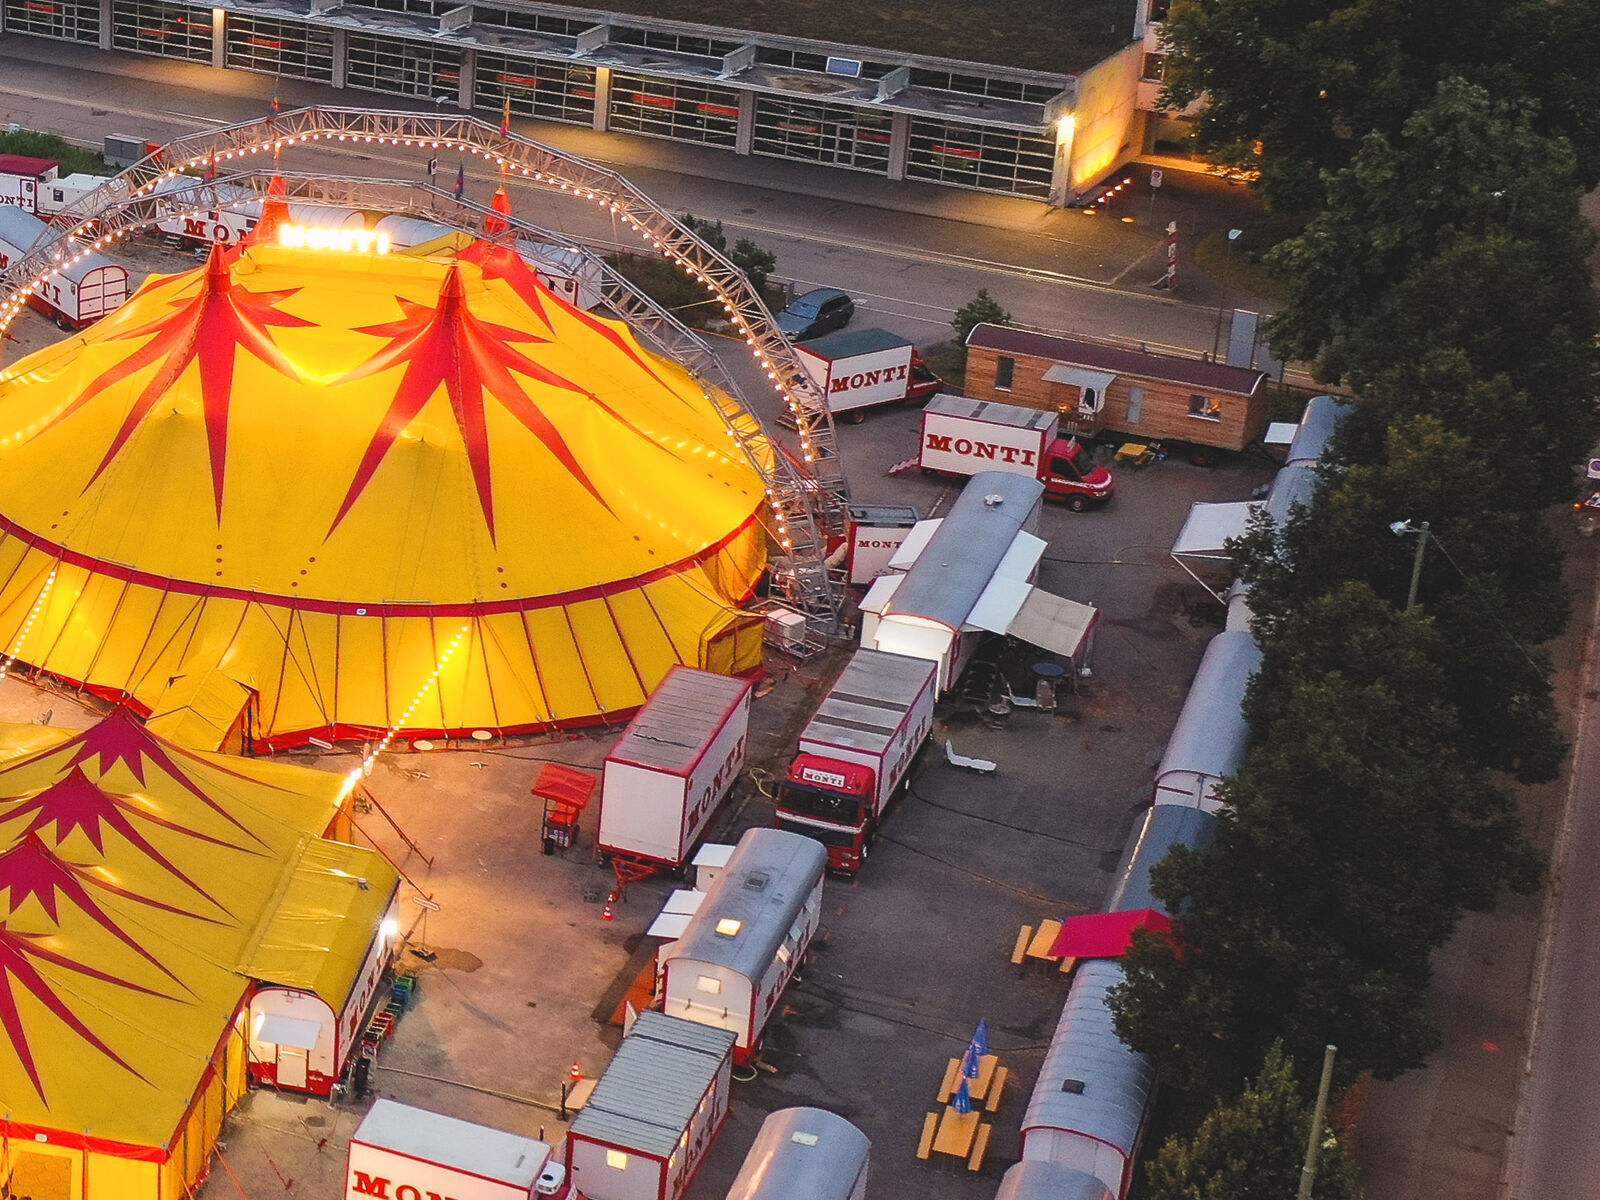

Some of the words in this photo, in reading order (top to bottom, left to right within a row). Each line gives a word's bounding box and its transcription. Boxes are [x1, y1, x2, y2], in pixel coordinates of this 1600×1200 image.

[612, 104, 618, 113] 3
[183, 218, 253, 243] MON
[280, 223, 391, 255] MONTI
[831, 364, 908, 393] MONTI
[926, 433, 1037, 467] MONTI
[858, 539, 903, 551] MONT
[687, 735, 745, 839] MONTI
[805, 772, 844, 786] MONTI
